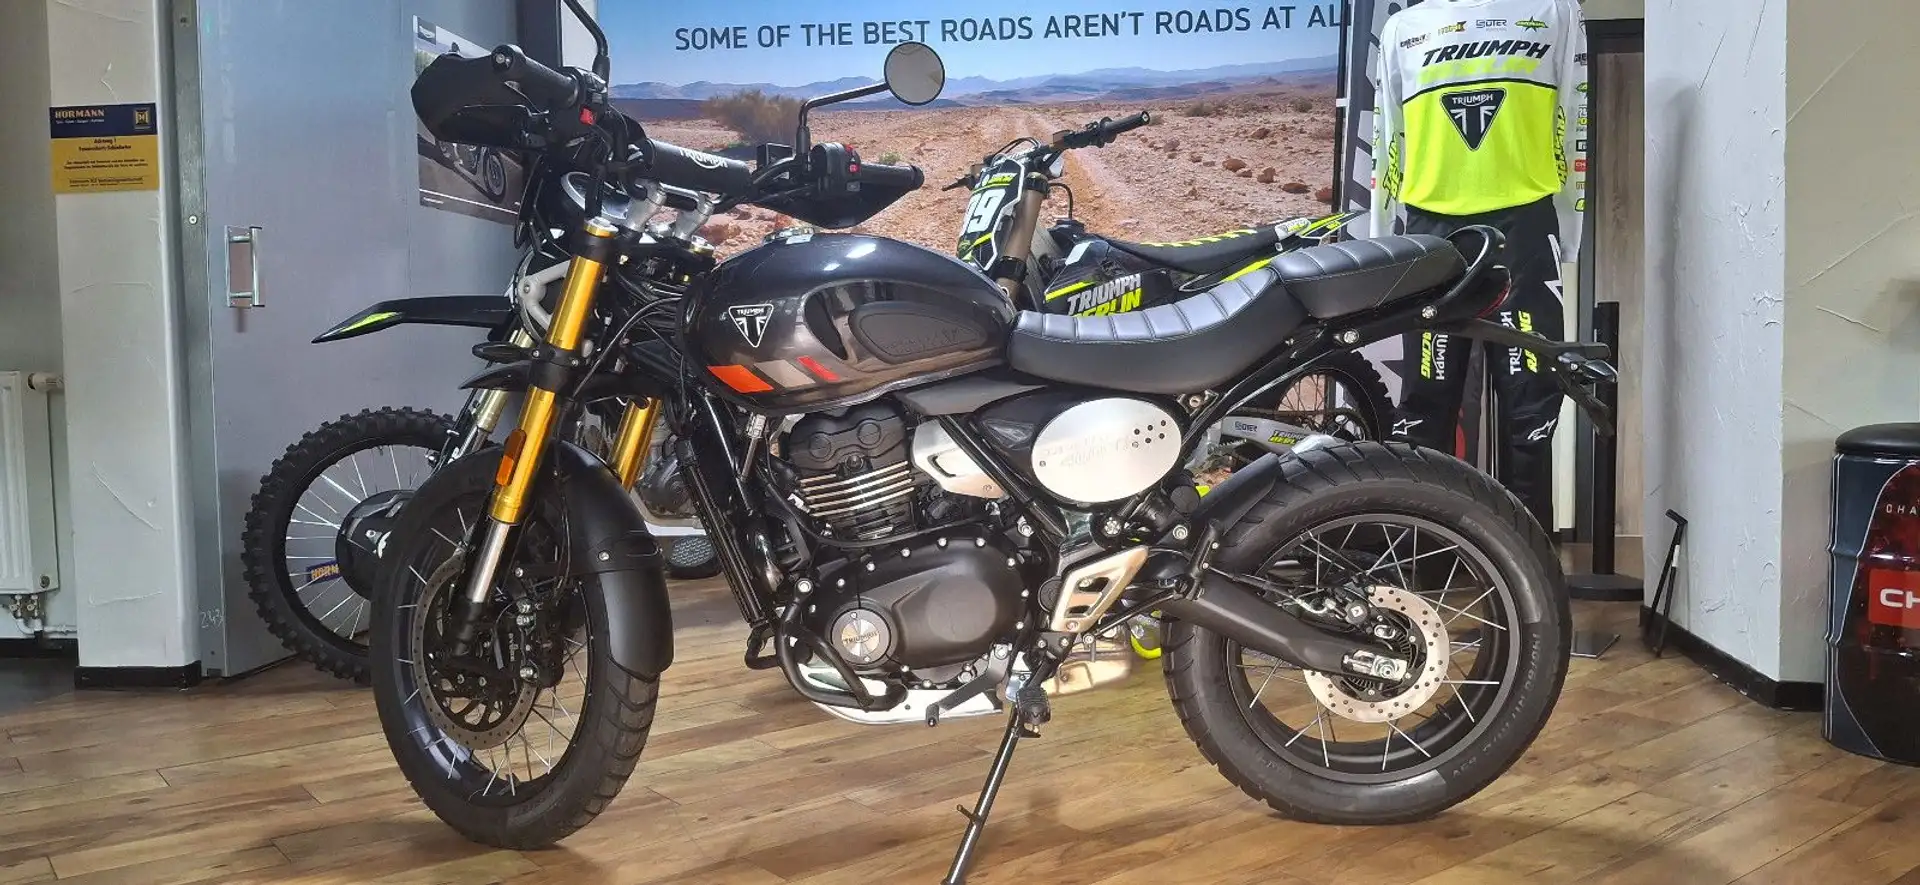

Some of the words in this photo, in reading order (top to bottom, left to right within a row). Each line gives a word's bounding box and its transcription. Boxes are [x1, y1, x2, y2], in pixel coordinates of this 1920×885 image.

[675, 27, 748, 50] SOME
[757, 25, 790, 48] OF
[801, 22, 853, 46] THE
[863, 20, 931, 44] BEST
[941, 16, 1034, 42] ROADS
[1043, 12, 1145, 38] AREN'T
[1155, 7, 1251, 34] ROADS
[1262, 6, 1296, 29] AT
[1306, 4, 1344, 27] AL
[1422, 40, 1551, 67] TRIUMPH
[1451, 94, 1494, 106] TRIUMPH
[1067, 273, 1142, 317] TRIUMPH
